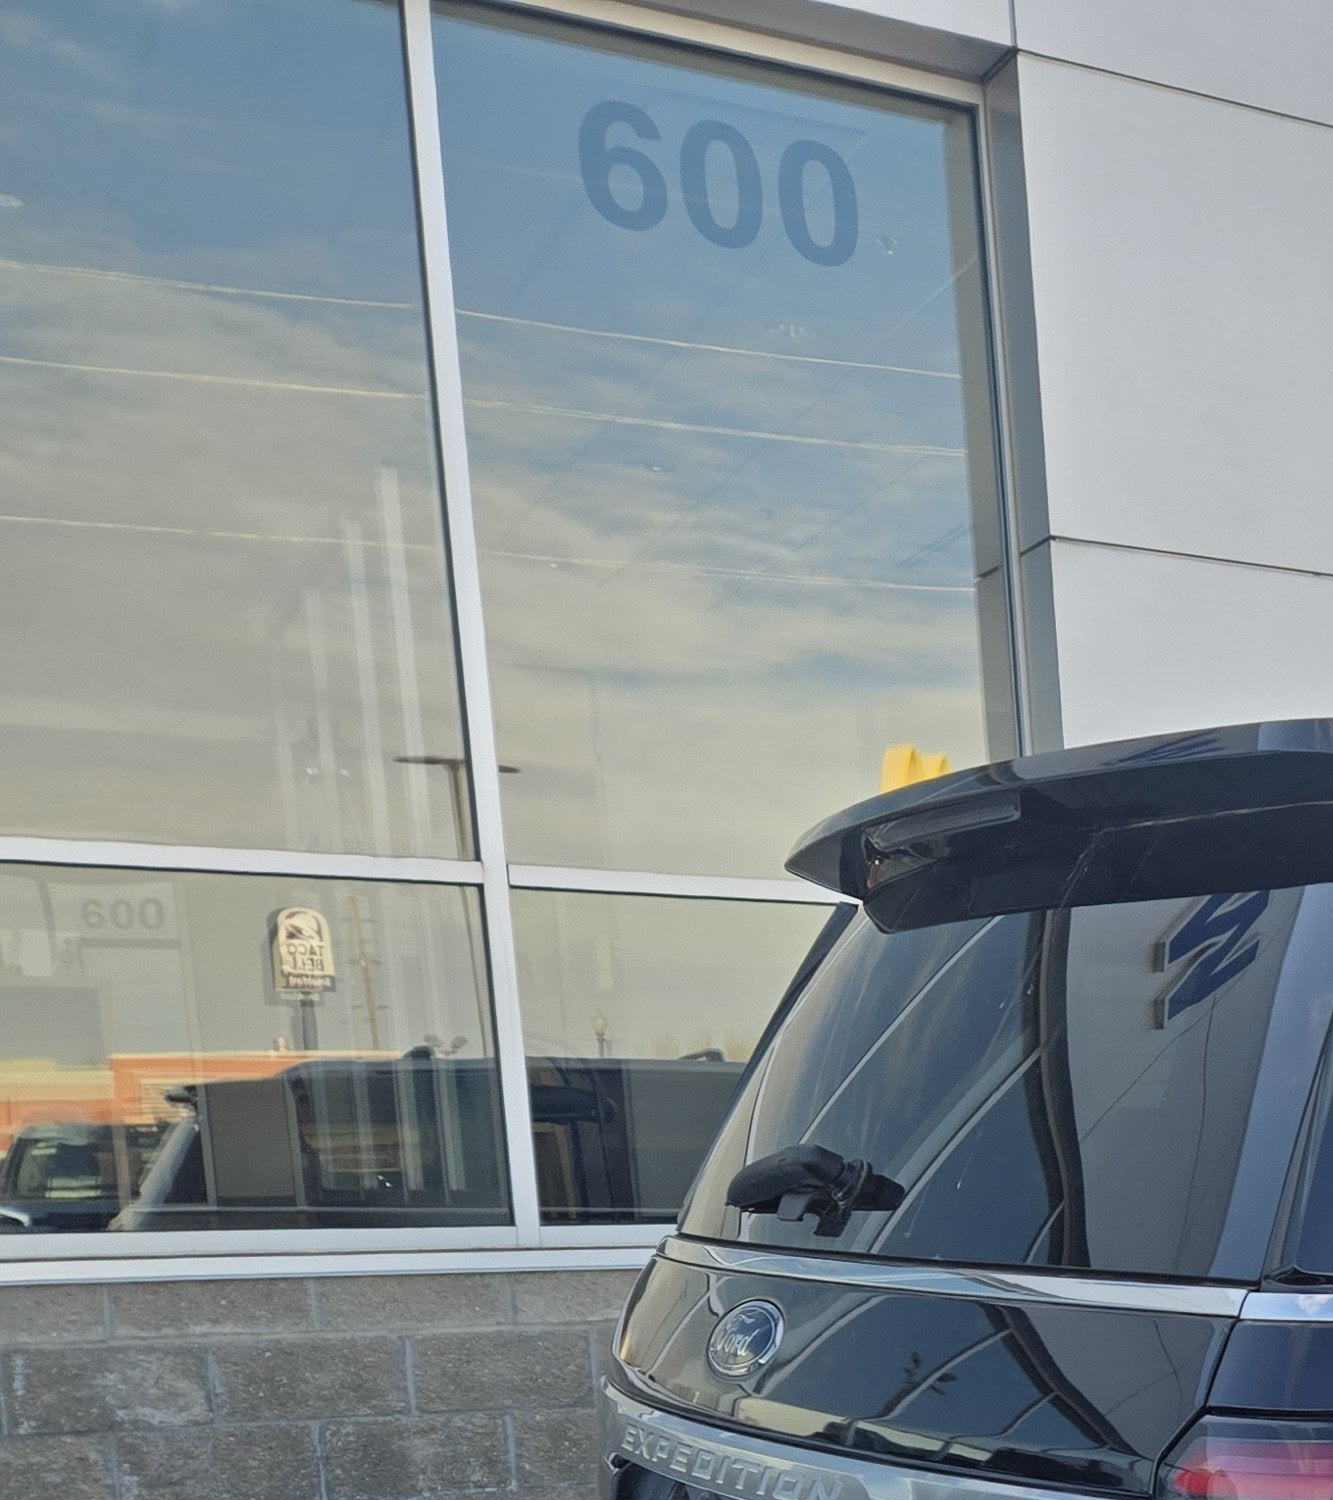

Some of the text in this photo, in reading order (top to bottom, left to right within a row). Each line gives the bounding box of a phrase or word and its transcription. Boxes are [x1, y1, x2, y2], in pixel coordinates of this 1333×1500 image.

[578, 100, 859, 267] 600
[80, 897, 164, 930] 600
[711, 1315, 760, 1356] Ford
